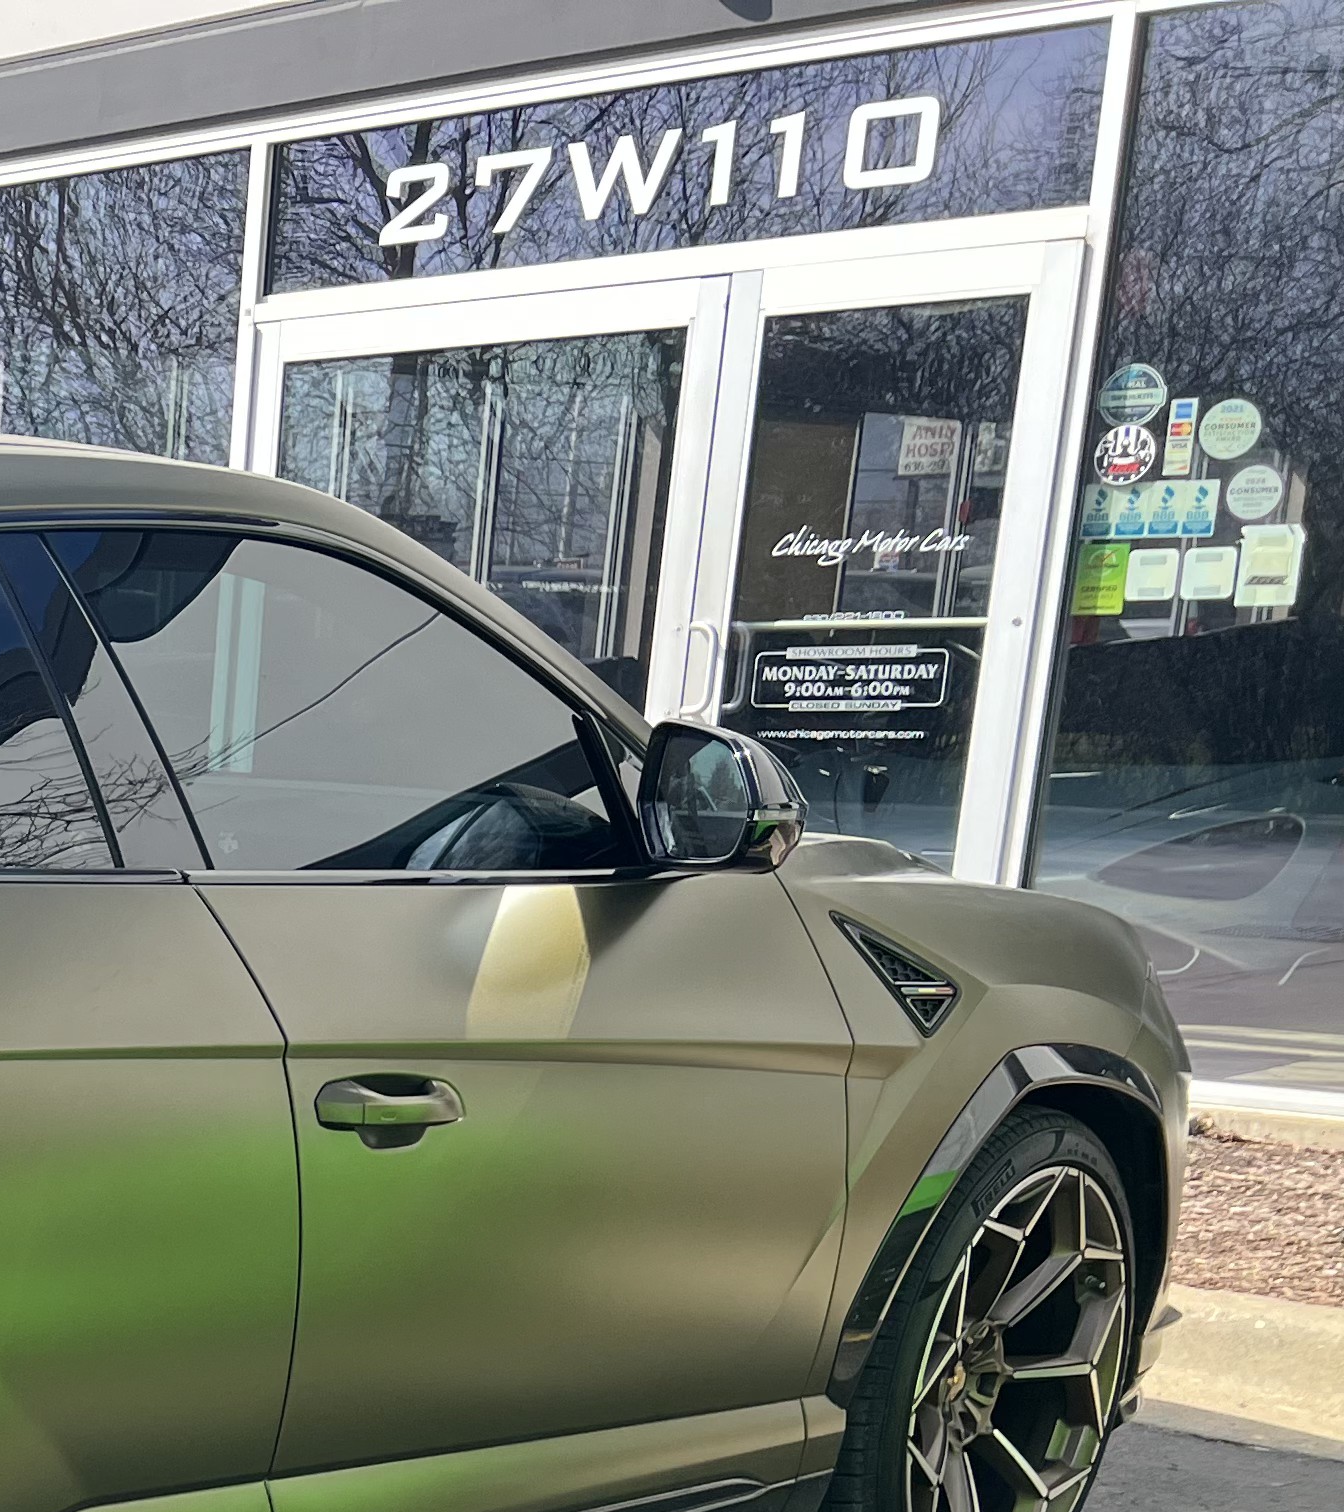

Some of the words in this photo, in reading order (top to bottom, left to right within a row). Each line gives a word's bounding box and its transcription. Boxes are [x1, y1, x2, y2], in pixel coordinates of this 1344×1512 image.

[378, 95, 940, 246] 27W110
[1204, 421, 1256, 431] CONSUMER
[1230, 486, 1279, 495] CONSUMER
[771, 525, 853, 566] Chicago
[853, 528, 920, 553] Motor
[919, 528, 970, 552] Cars
[791, 647, 866, 658] SHOWROOM
[869, 646, 912, 657] HOURS
[757, 728, 925, 741] www.chicagomotorcars.com
[972, 1157, 1016, 1220] PIRELLI
